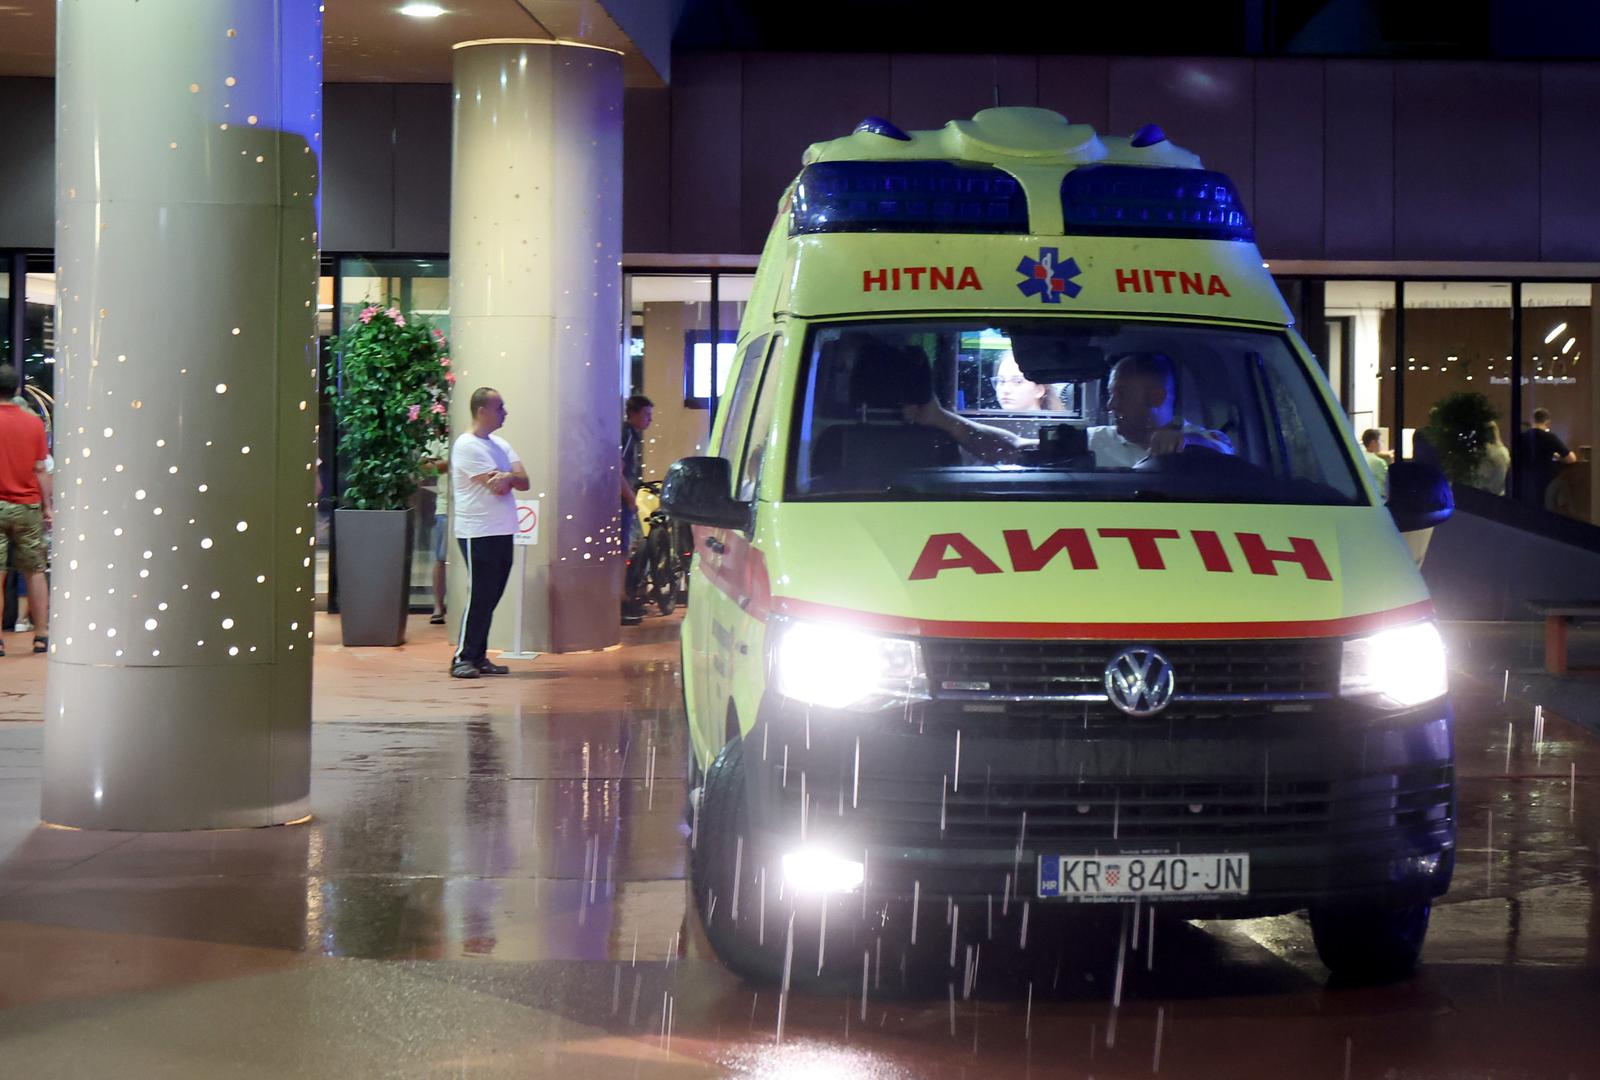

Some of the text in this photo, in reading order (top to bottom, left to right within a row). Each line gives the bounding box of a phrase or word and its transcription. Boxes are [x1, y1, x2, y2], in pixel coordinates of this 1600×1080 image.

[863, 266, 983, 292] HITNA
[1115, 268, 1231, 297] HITNA
[1042, 880, 1057, 890] HR
[1063, 858, 1243, 892] KR 840-JN
